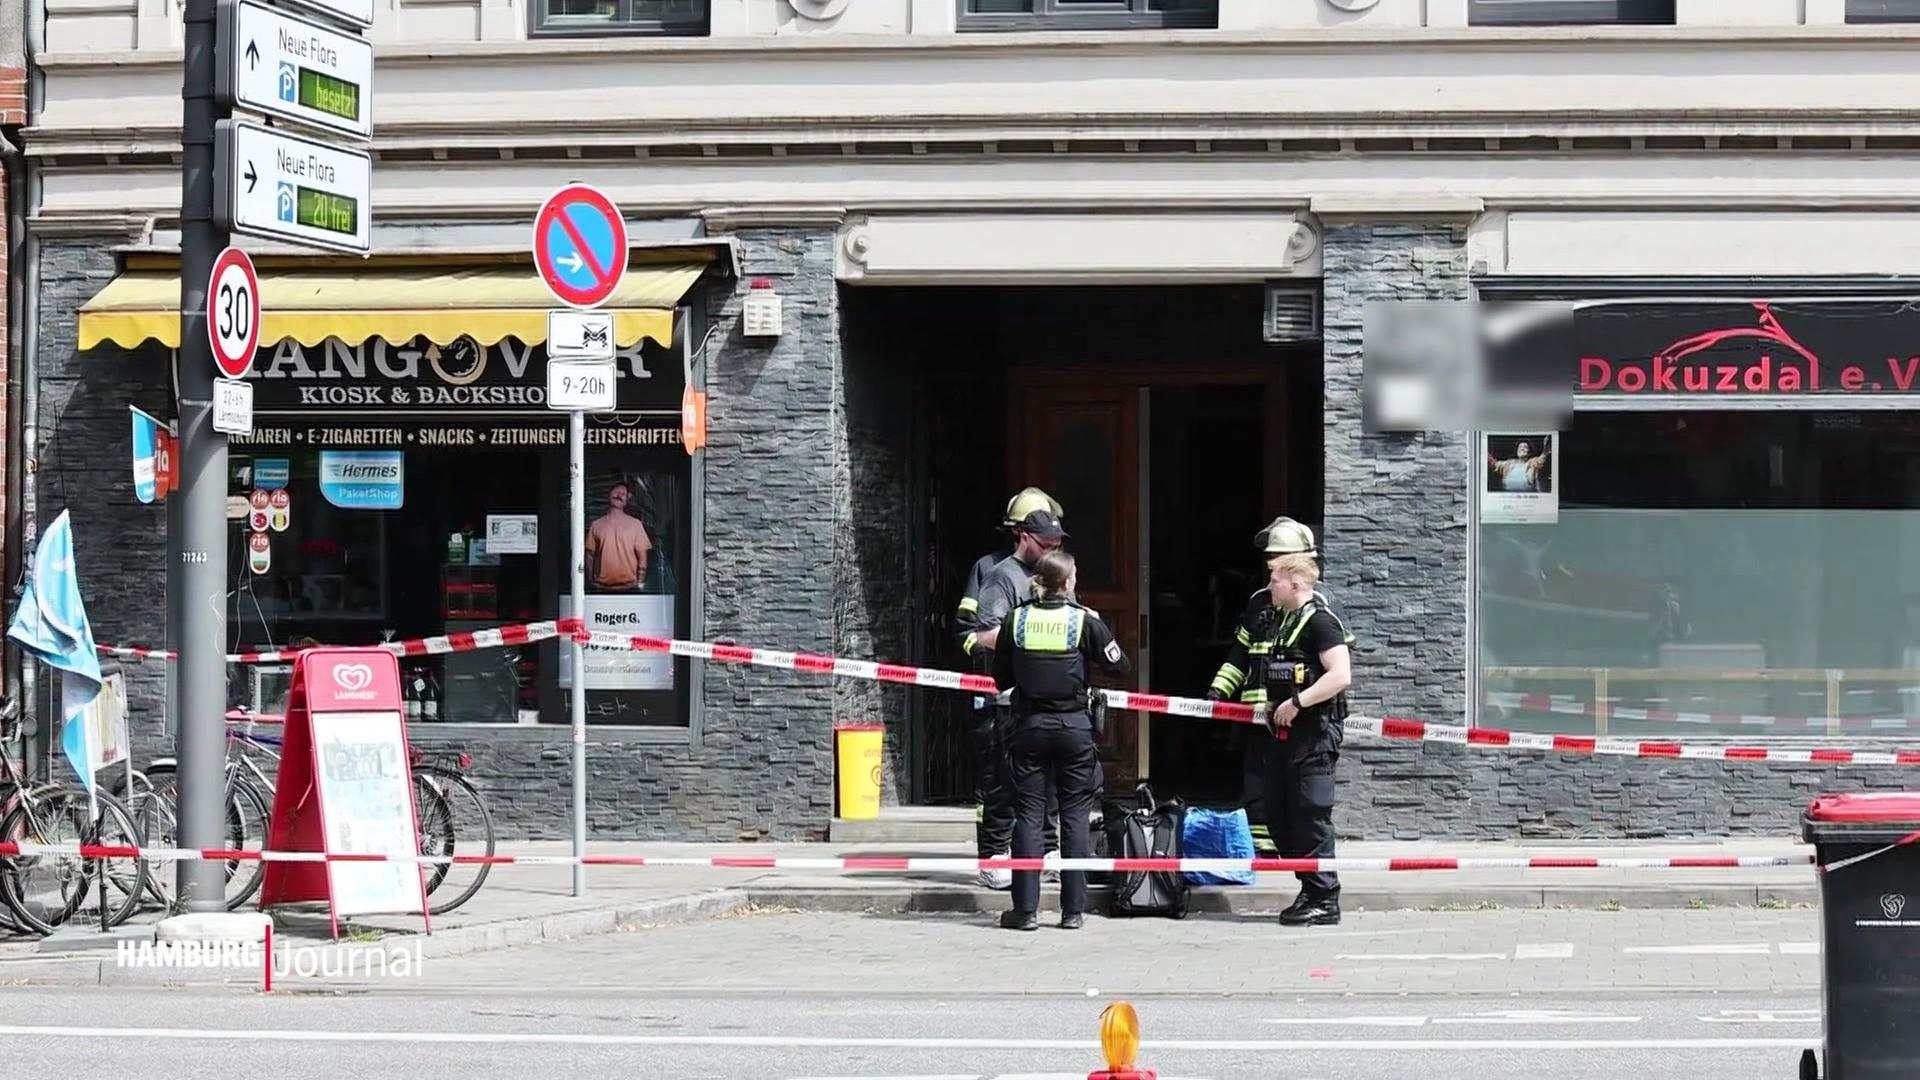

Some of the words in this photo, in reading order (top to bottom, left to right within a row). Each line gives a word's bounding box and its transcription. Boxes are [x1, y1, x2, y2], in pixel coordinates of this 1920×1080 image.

[279, 28, 308, 58] Neue
[310, 38, 338, 68] Flora
[316, 75, 356, 117] besetzt
[277, 148, 306, 176] Neue
[308, 157, 335, 183] Flora
[313, 193, 328, 226] 20
[331, 196, 351, 232] frei
[220, 282, 249, 340] 30
[1580, 356, 1820, 392] Dokuzdal
[299, 386, 384, 405] KIOSK
[391, 386, 411, 405] &
[417, 385, 548, 405] BACKSHO
[308, 428, 402, 445] E-ZIGARETTEN
[419, 428, 474, 446] SNACKS
[490, 428, 566, 445] ZEITUNGEN
[342, 465, 398, 478] Hermes
[338, 488, 399, 500] PaketShop
[594, 612, 627, 625] Roger
[629, 612, 640, 624] G.
[1026, 621, 1067, 636] POLIZEI
